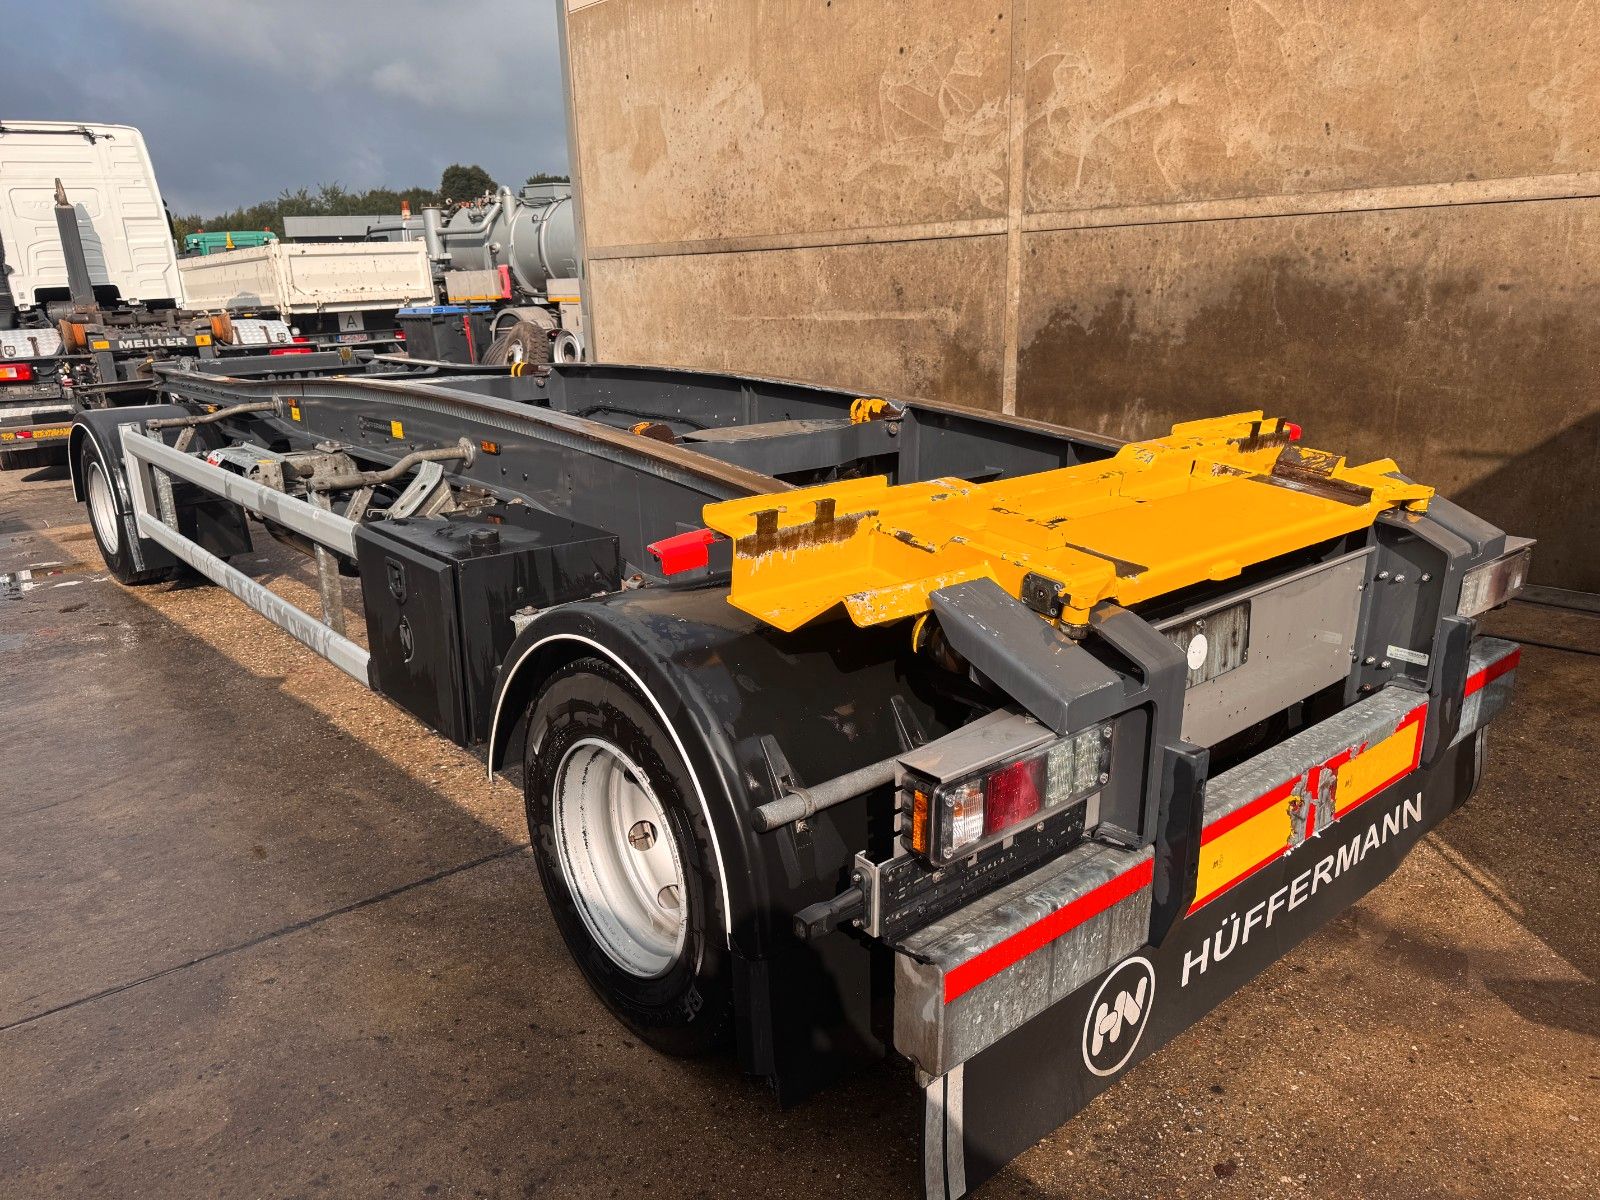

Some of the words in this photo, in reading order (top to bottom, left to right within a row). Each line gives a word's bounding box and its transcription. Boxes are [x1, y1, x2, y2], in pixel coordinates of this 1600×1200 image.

[346, 314, 358, 329] A
[118, 337, 188, 349] MEILLER
[1180, 791, 1423, 988] HÜFFERMANN
